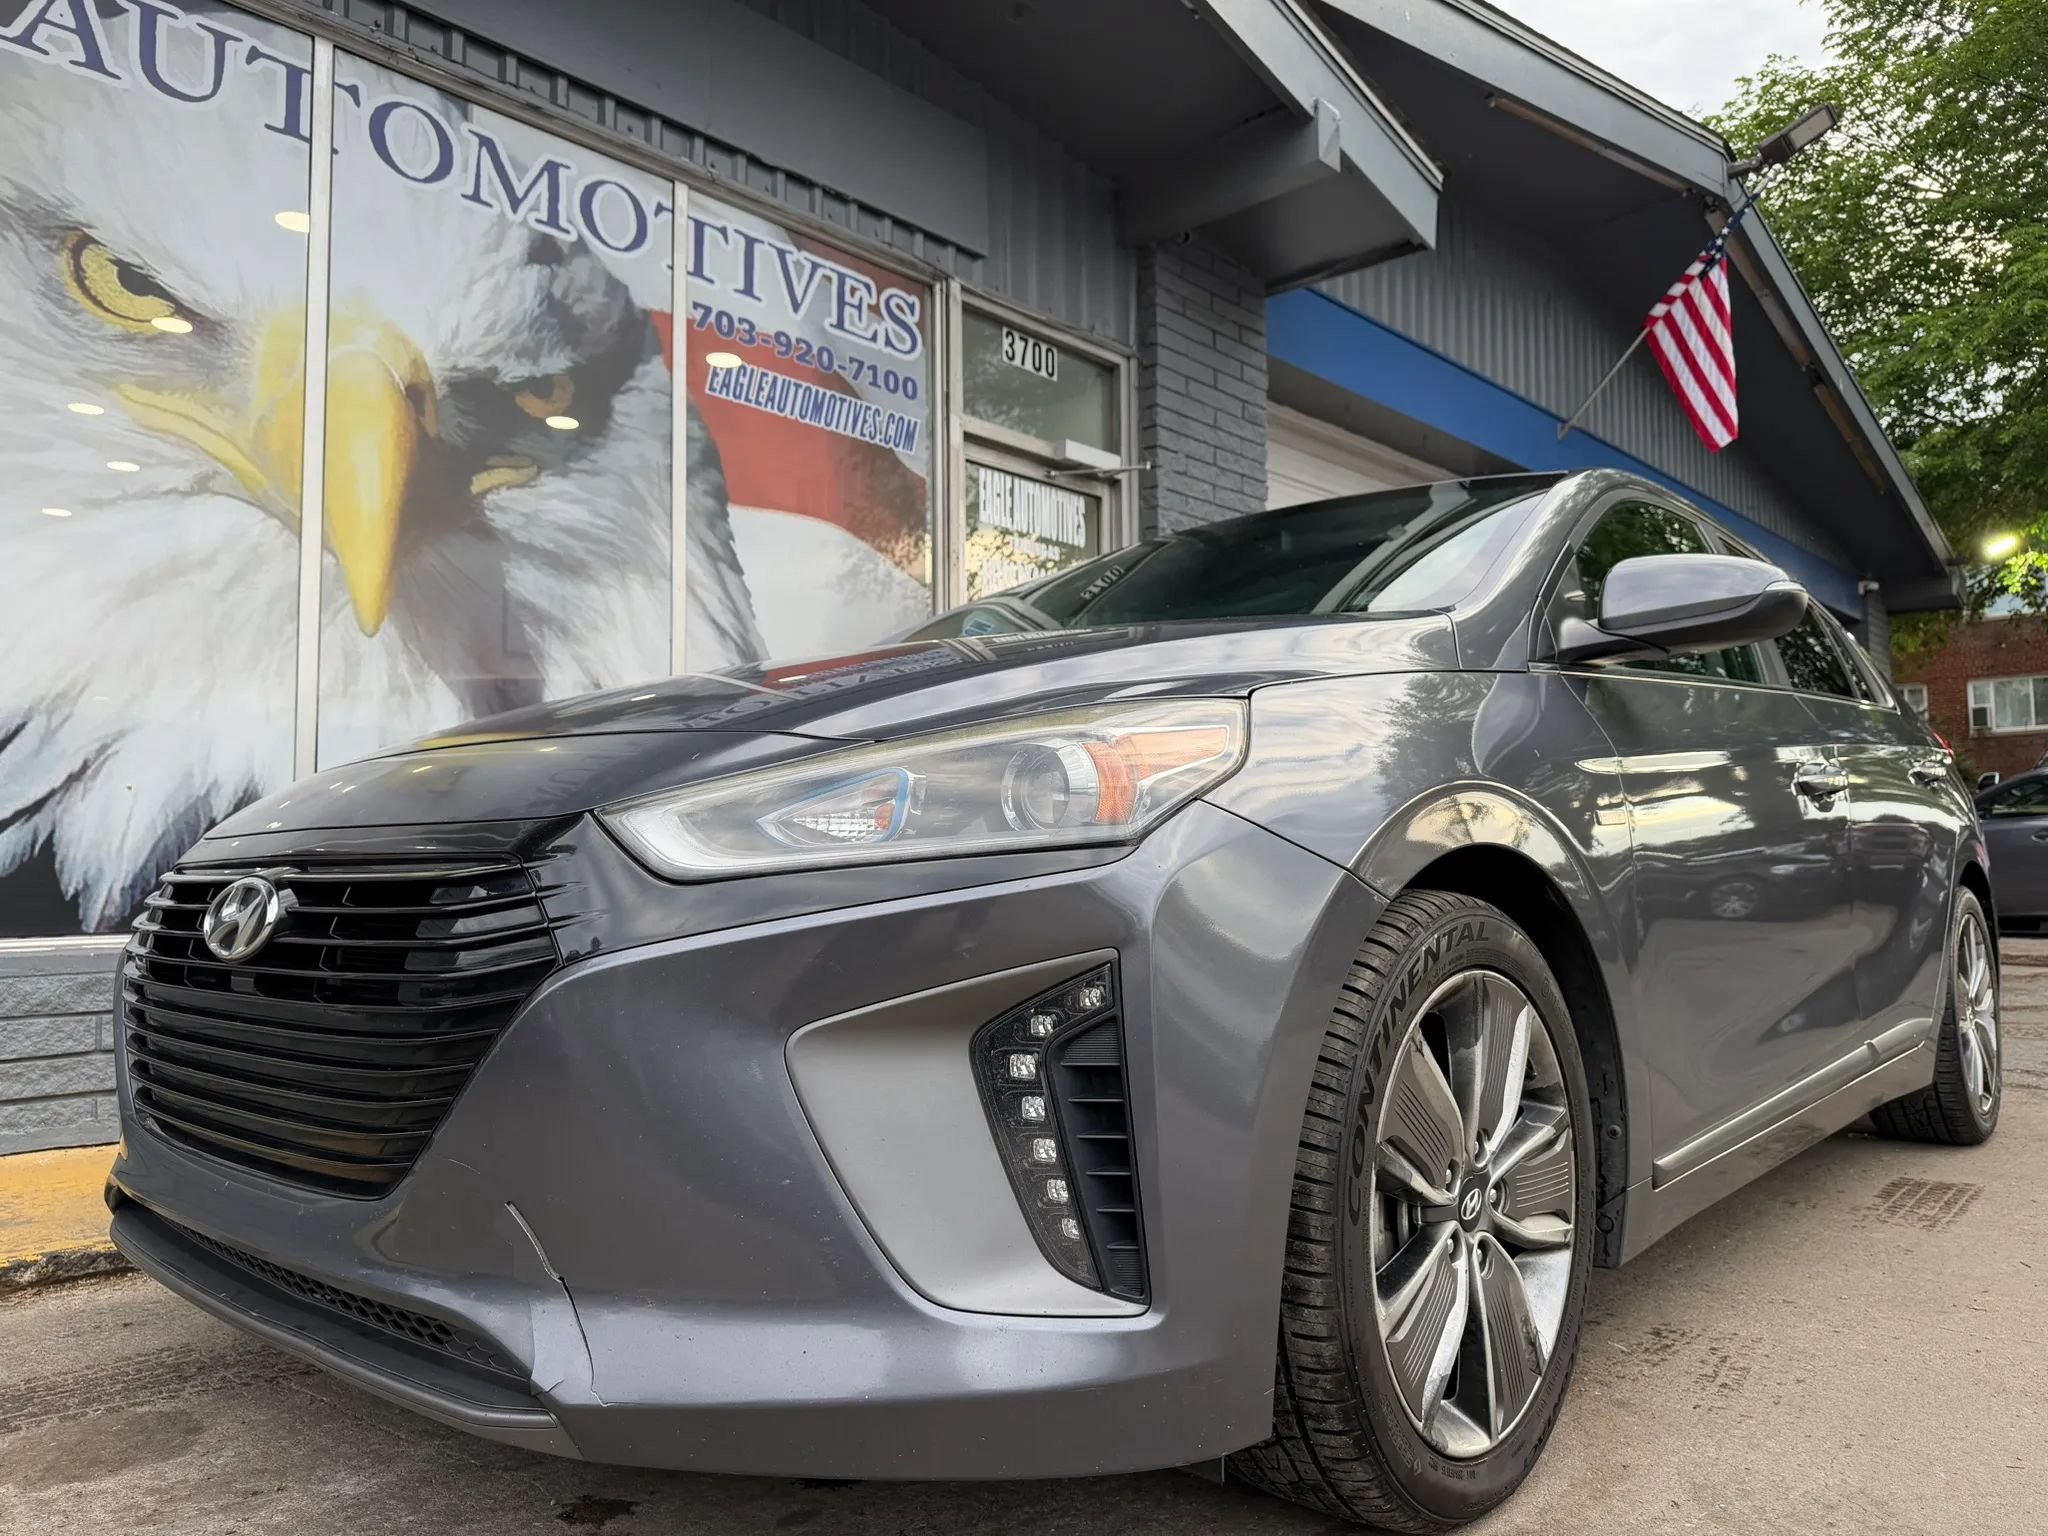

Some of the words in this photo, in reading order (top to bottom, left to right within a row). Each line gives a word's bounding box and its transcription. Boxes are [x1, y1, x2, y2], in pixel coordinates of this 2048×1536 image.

[2, 0, 919, 356] AUTOMOTIVES
[692, 301, 918, 400] 703-920-7100
[1005, 330, 1056, 378] 3700
[708, 361, 918, 452] EAGLEAUTOMOTIVES.COM
[1349, 921, 1490, 1227] CONTINENTAL
